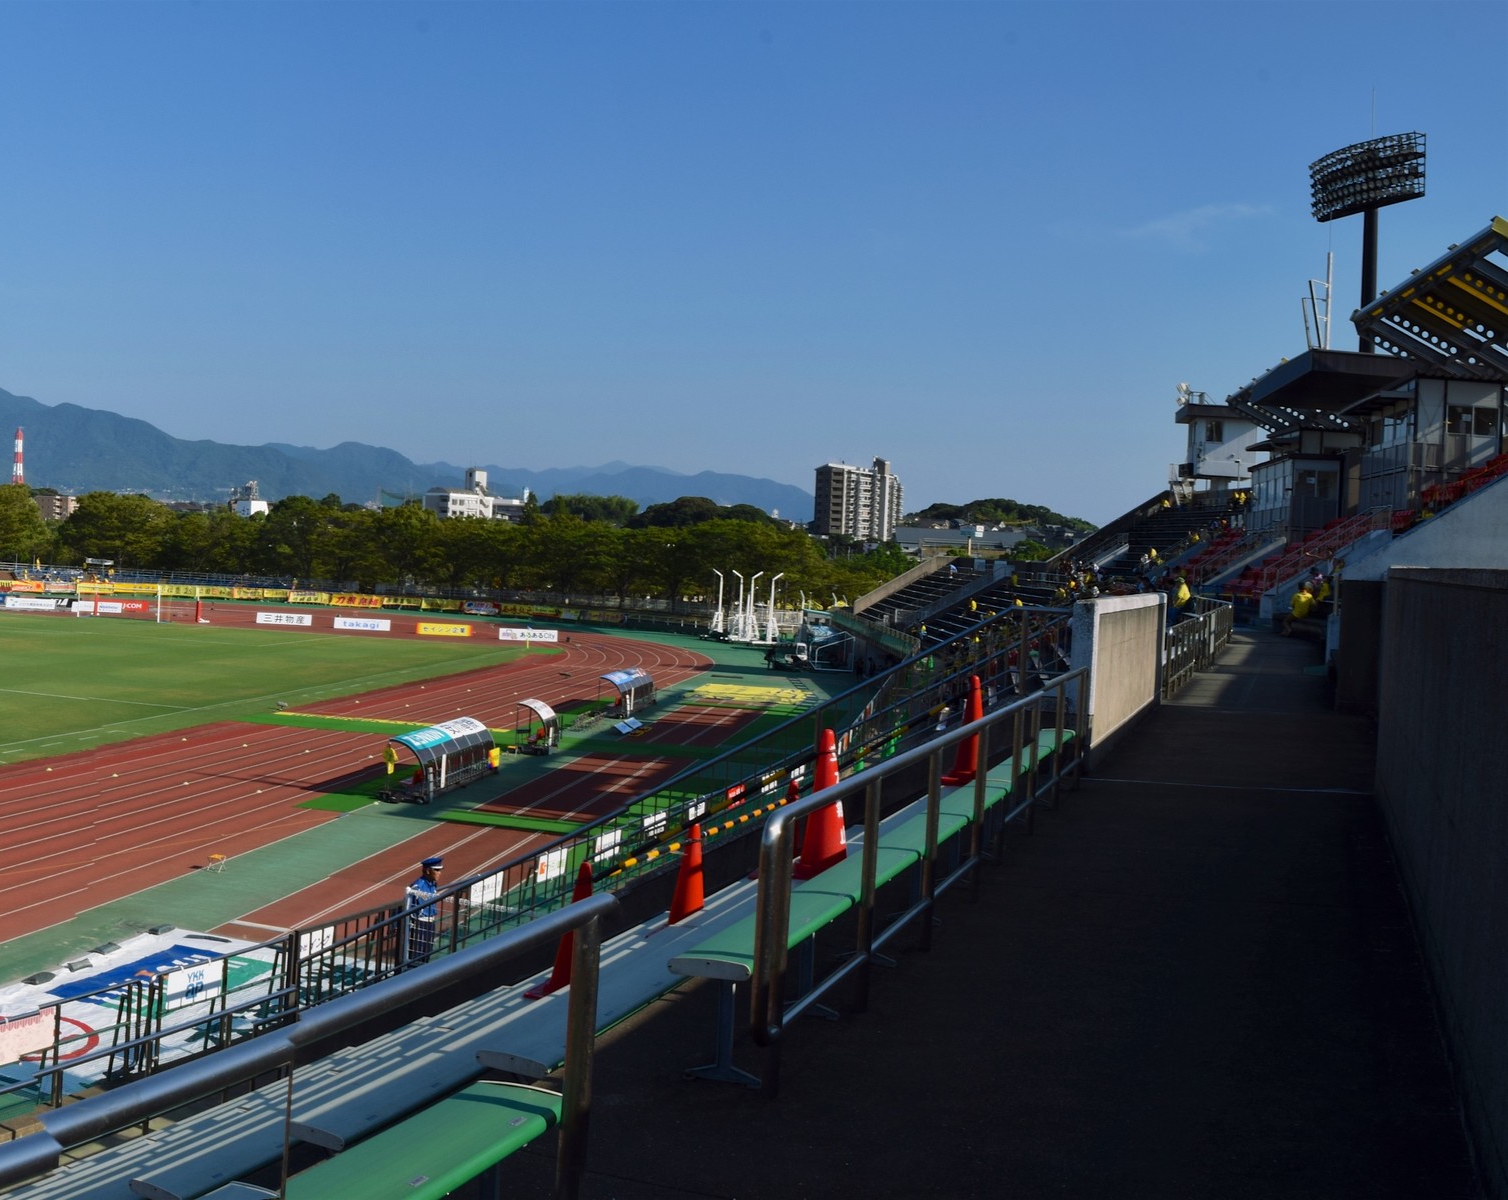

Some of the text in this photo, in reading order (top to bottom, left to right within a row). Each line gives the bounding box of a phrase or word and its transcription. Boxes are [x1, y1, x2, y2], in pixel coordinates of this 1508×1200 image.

[263, 614, 305, 624] 三井物産
[343, 620, 380, 631] takagi
[423, 625, 466, 634] セイシン企業
[187, 969, 204, 983] YKK
[185, 981, 204, 999] AP
